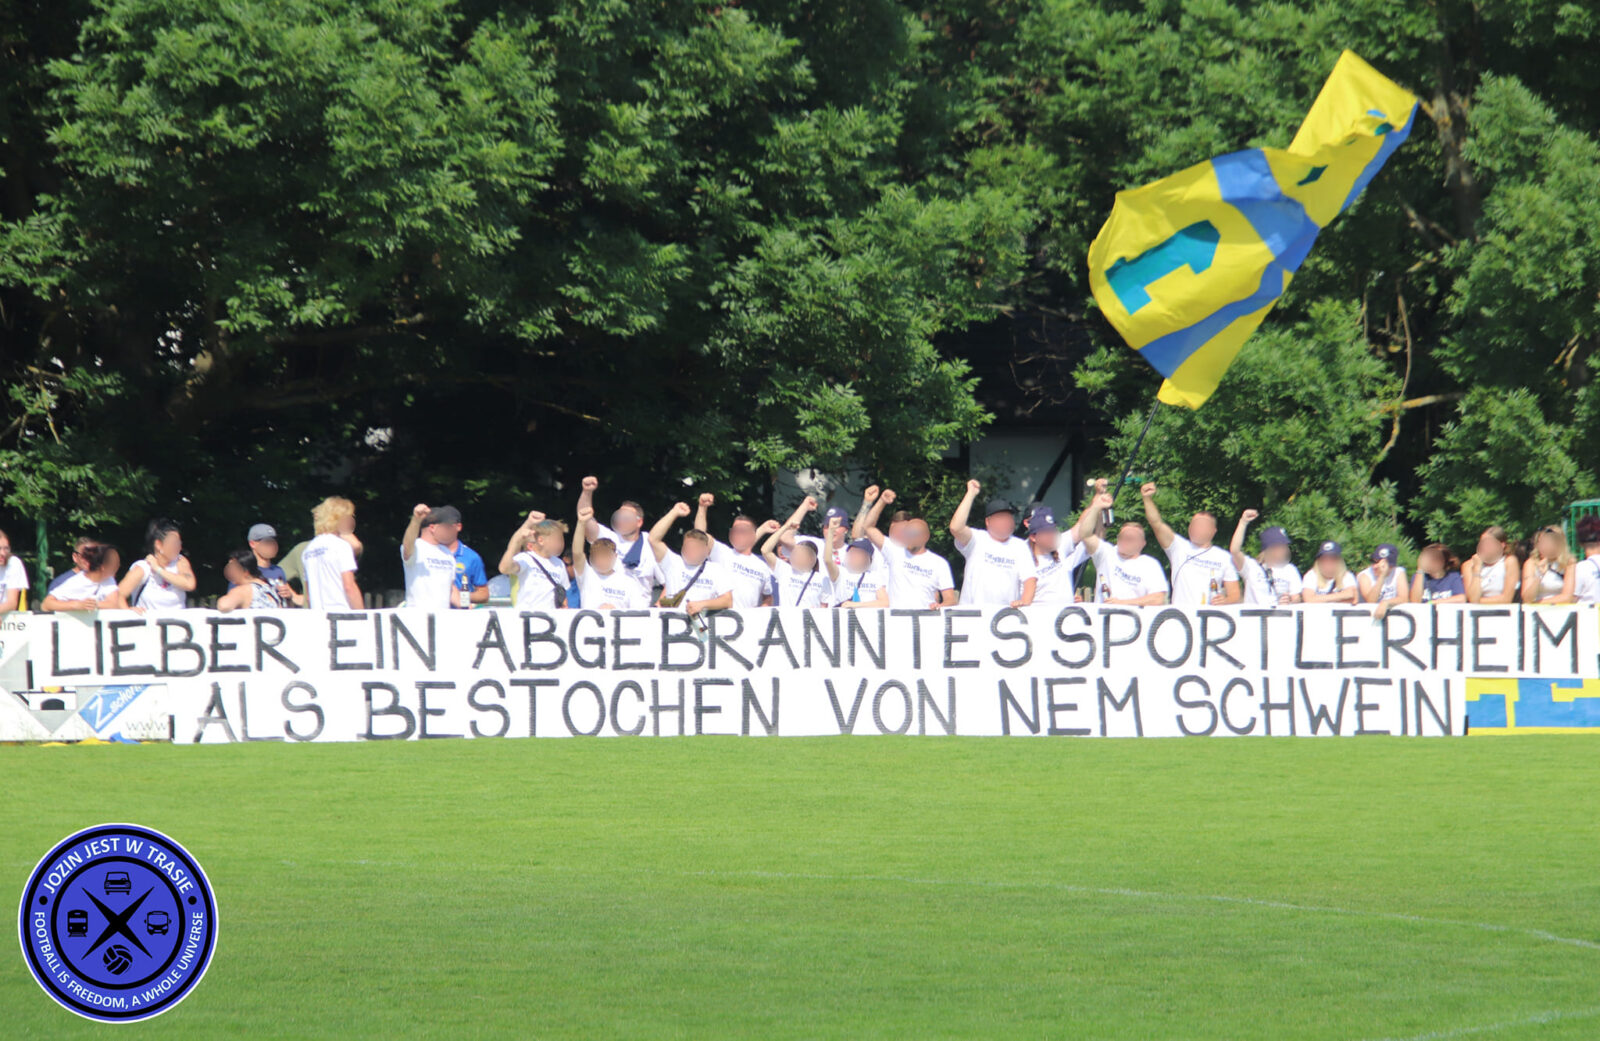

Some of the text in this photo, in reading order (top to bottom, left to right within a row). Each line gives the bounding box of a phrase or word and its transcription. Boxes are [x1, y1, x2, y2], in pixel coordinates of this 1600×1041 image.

[51, 605, 1578, 678] LIEBER EIN ABGEBRANNTES SPORTLERHEIM
[193, 674, 1452, 743] ALS BESTOCHEN VON NEM SCHWEIN
